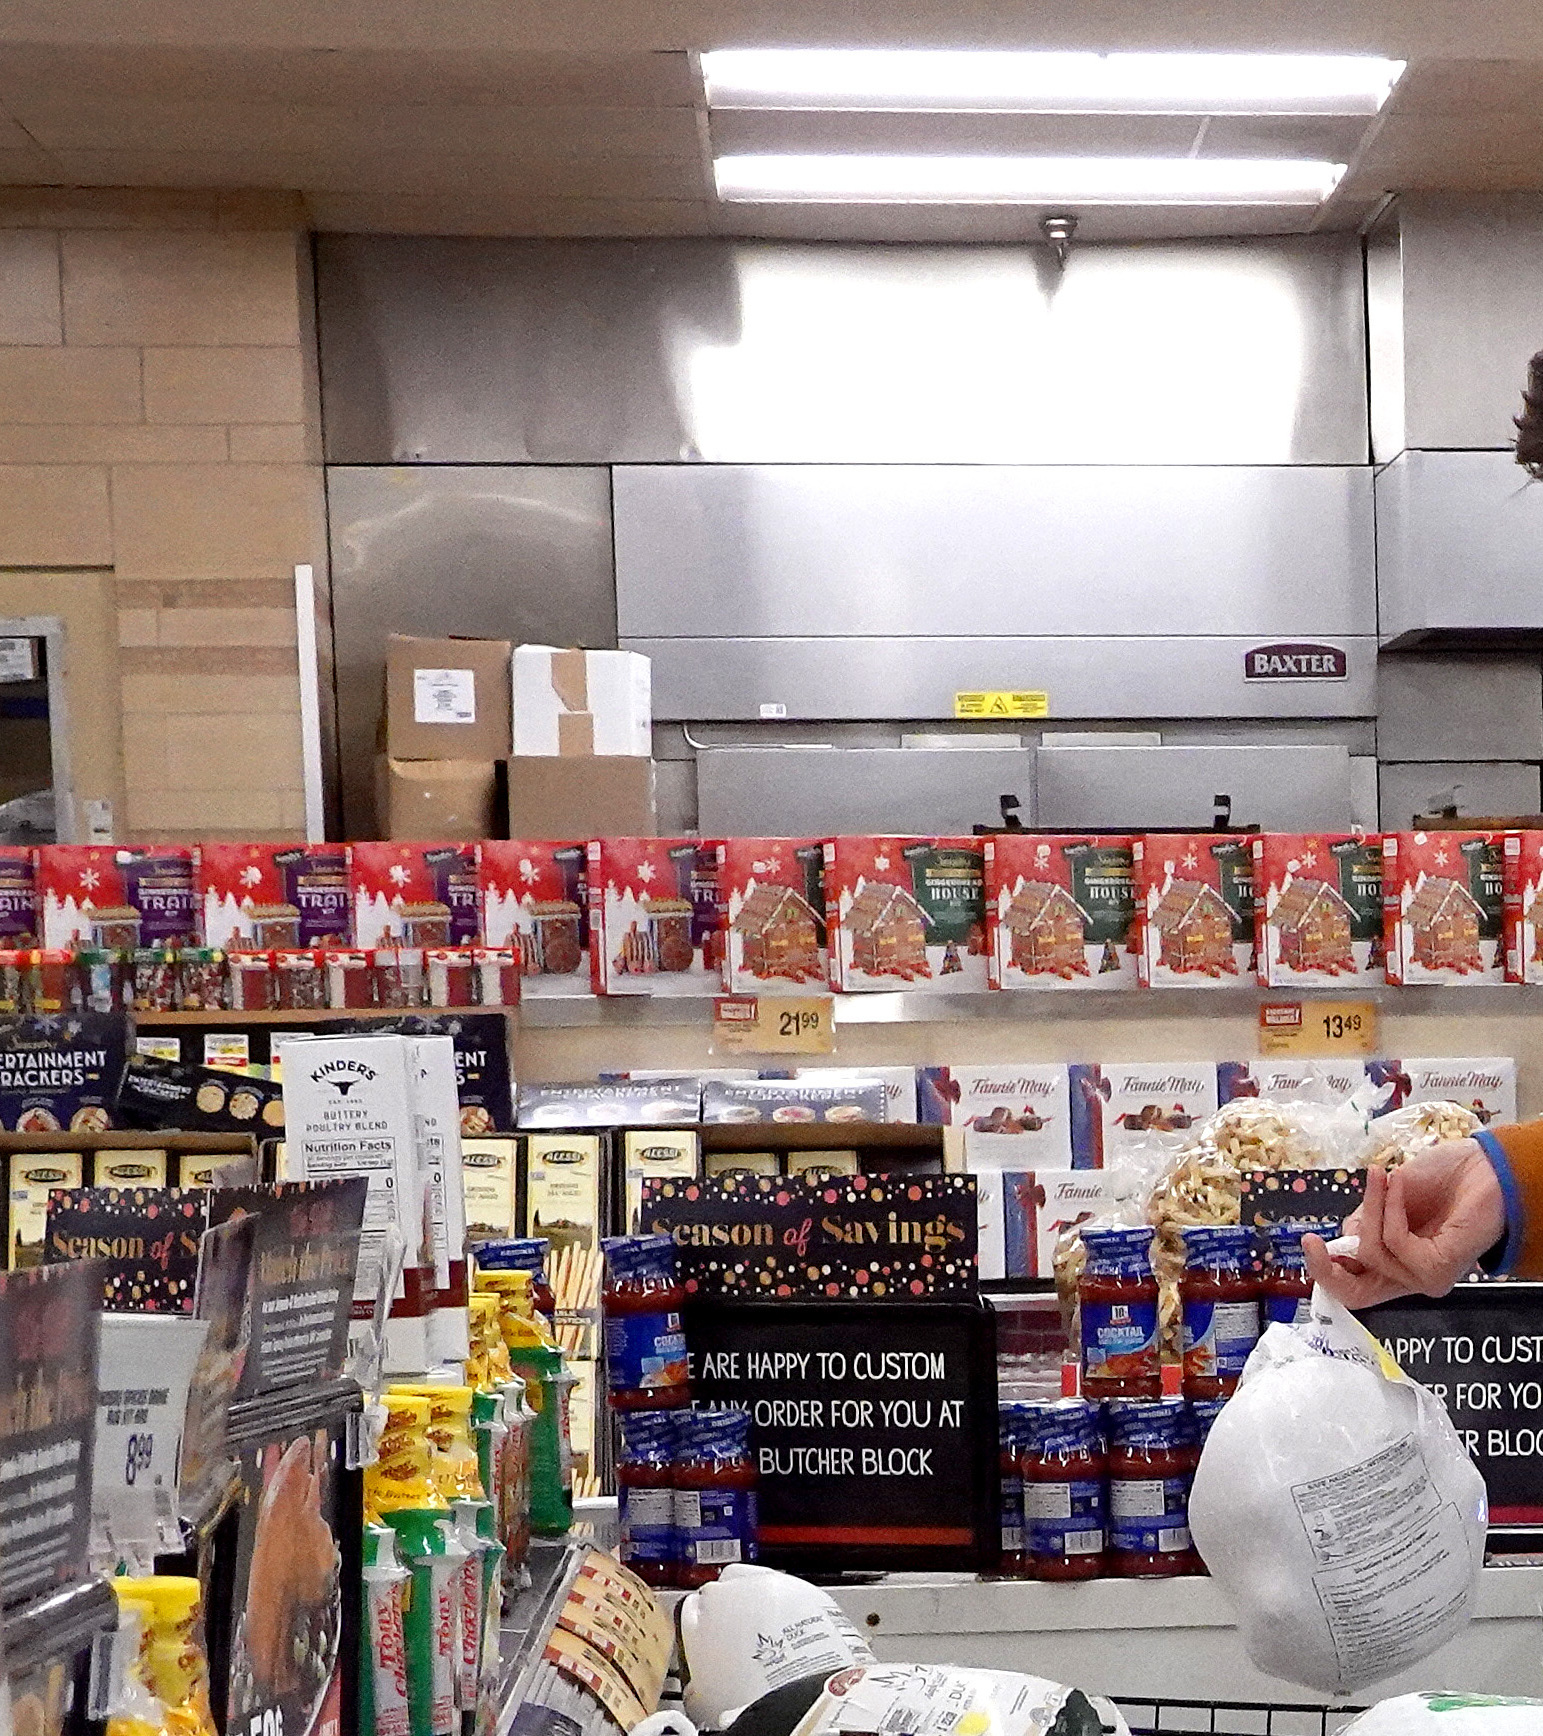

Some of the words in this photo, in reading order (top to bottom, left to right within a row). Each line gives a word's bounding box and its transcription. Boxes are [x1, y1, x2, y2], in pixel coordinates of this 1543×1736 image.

[1253, 652, 1337, 674] BAXTER
[309, 1059, 380, 1083] KINDER'S
[1419, 1070, 1463, 1090] Fannie
[968, 1077, 1017, 1097] Fannie
[1122, 1076, 1167, 1094] Fannie
[323, 1109, 369, 1121] BUTTERY
[355, 1120, 388, 1131] BLEND
[304, 1140, 357, 1153] Nutrition
[359, 1140, 393, 1152] Facts
[1054, 1182, 1102, 1200] Fannie
[782, 1217, 813, 1257] of
[820, 1210, 966, 1254] Savings
[52, 1231, 146, 1260] Season
[149, 1230, 175, 1270] of
[1384, 1337, 1437, 1365] APPY
[1441, 1336, 1475, 1364] TO
[702, 1352, 741, 1380] ARE
[747, 1352, 811, 1380] HAPPY
[815, 1352, 847, 1380] TO
[853, 1352, 946, 1380] CUSTOM
[1455, 1382, 1502, 1410] FOR
[754, 1399, 824, 1428] ORDER
[830, 1399, 874, 1428] FOR
[879, 1399, 932, 1428] YOU
[937, 1399, 965, 1428] AT
[758, 1447, 855, 1476] BUTCHER
[861, 1447, 934, 1476] BLOCK
